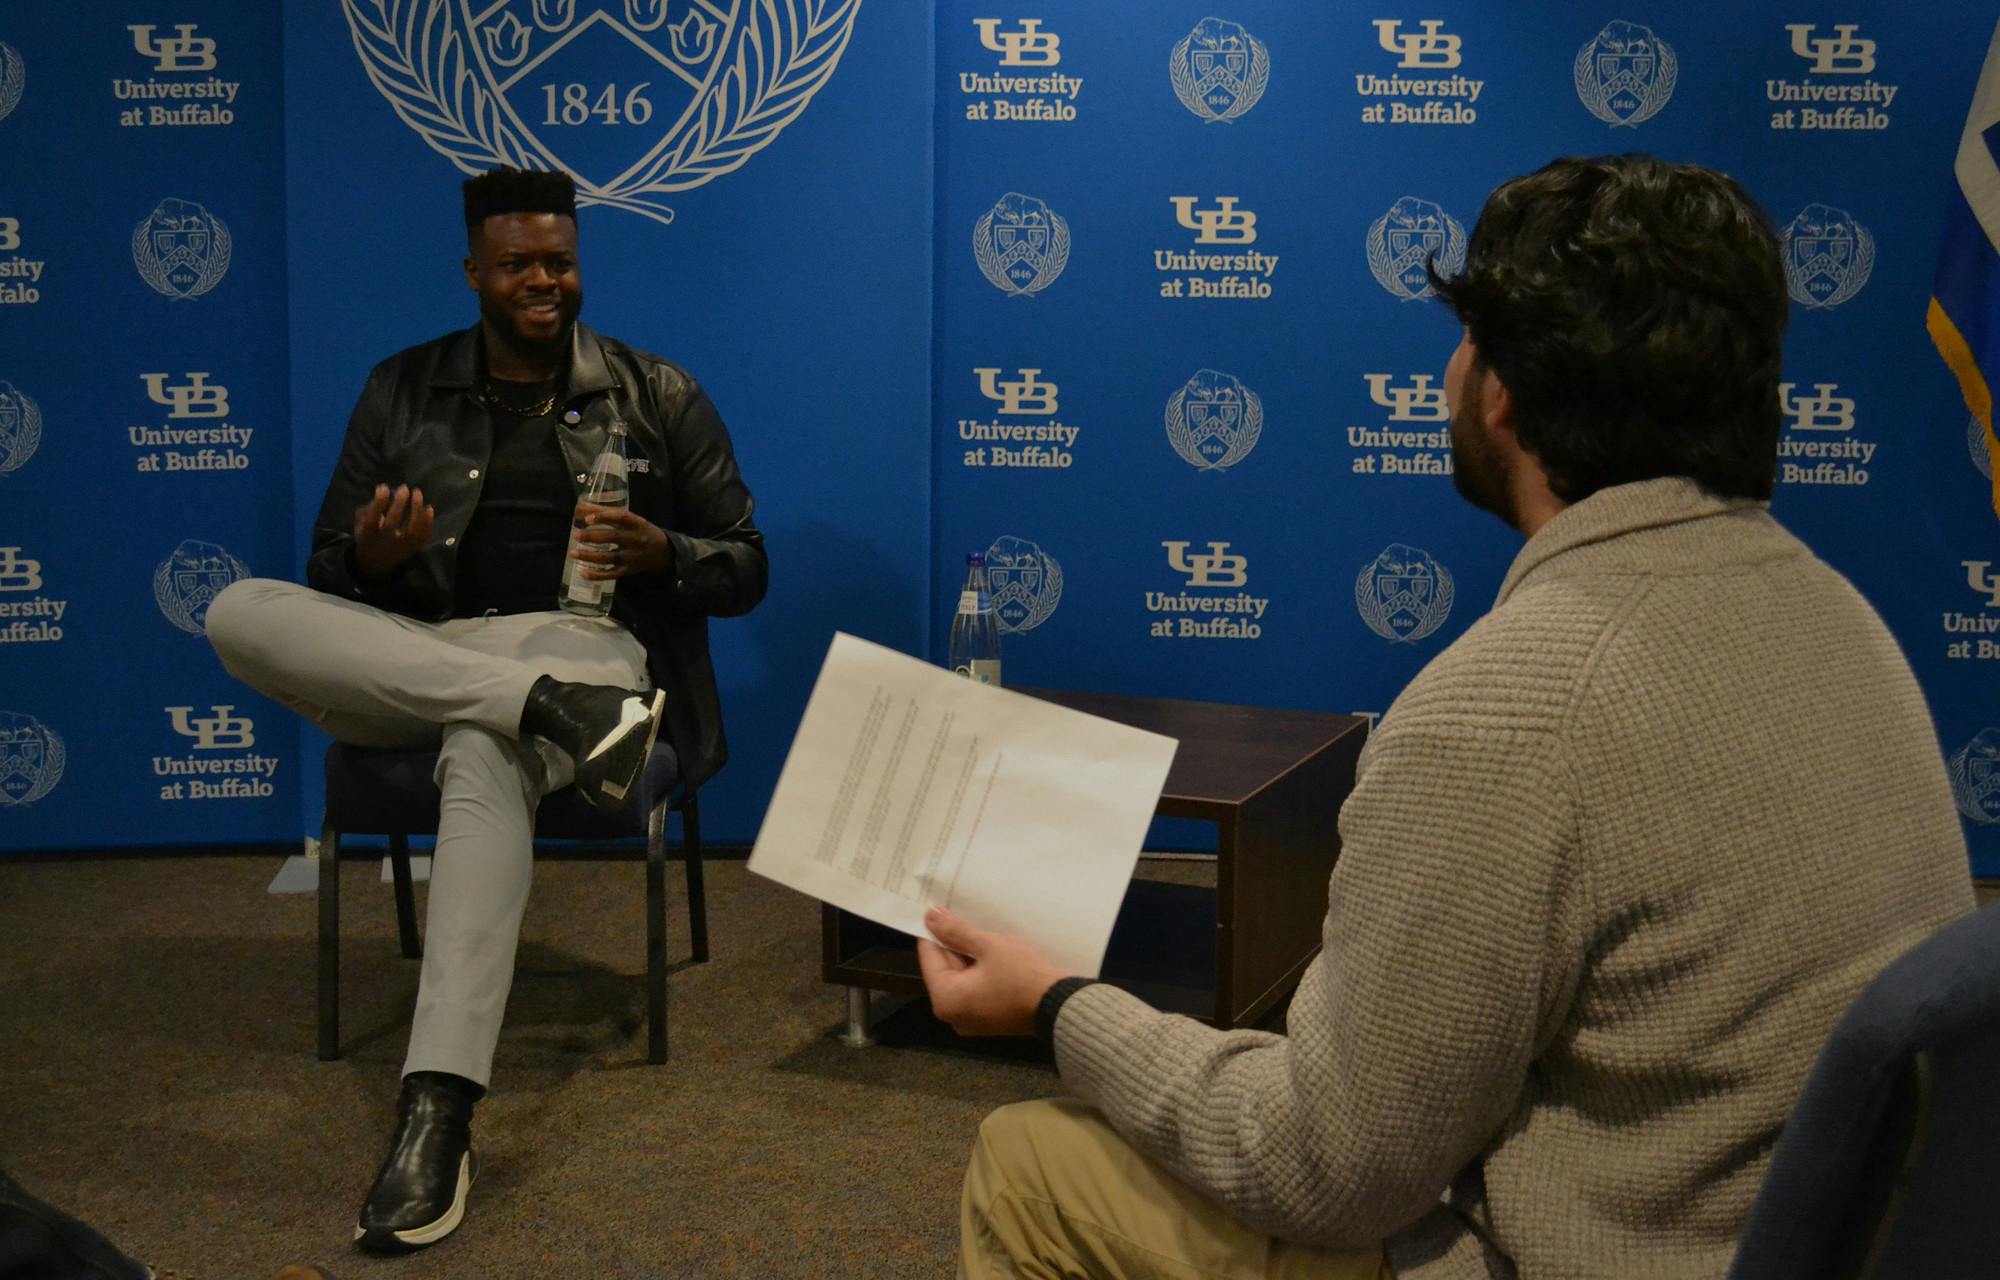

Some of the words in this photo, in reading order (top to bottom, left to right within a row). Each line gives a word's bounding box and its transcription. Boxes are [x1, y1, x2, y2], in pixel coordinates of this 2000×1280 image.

[127, 24, 217, 71] UB
[973, 19, 1060, 66] UB
[1373, 20, 1461, 68] UB
[1785, 24, 1876, 73] UB
[113, 77, 240, 103] University
[960, 72, 1083, 99] University
[1356, 74, 1484, 102] University
[1766, 80, 1898, 107] University
[542, 83, 652, 125] 1846
[966, 101, 988, 120] at
[994, 99, 1076, 121] Buffalo
[1209, 95, 1230, 106] 1846
[1362, 104, 1384, 123] at
[1391, 101, 1476, 124] Buffalo
[121, 108, 143, 126] at
[149, 104, 233, 125] Buffalo
[1771, 110, 1795, 128] at
[1800, 107, 1889, 129] Buffalo
[1170, 197, 1256, 243] UB
[1011, 269, 1031, 280] 1846
[1155, 249, 1278, 277] University
[1161, 279, 1183, 297] at
[1188, 276, 1272, 298] Buffalo
[140, 373, 229, 418] UB
[974, 368, 1058, 414] UB
[1364, 374, 1450, 421] UB
[129, 423, 253, 448] University
[959, 420, 1079, 447] University
[1347, 426, 1452, 448] Universi
[138, 454, 160, 471] at
[165, 449, 248, 470] Buffalo
[964, 448, 986, 466] at
[991, 446, 1072, 467] Buffalo
[1776, 436, 1876, 464] iversity
[1353, 455, 1375, 473] at
[1381, 453, 1453, 475] Buffal
[1782, 463, 1868, 485] Buffalo
[1162, 541, 1247, 587] UB
[0, 596, 66, 620] ersity
[1146, 592, 1268, 619] University
[0, 621, 63, 643] uffalo
[1151, 619, 1173, 637] at
[1179, 617, 1261, 639] Buffalo
[1948, 641, 1971, 658] at
[165, 705, 255, 749] UB
[153, 753, 278, 780] University
[161, 782, 183, 799] at
[189, 778, 273, 799] Buffalo
